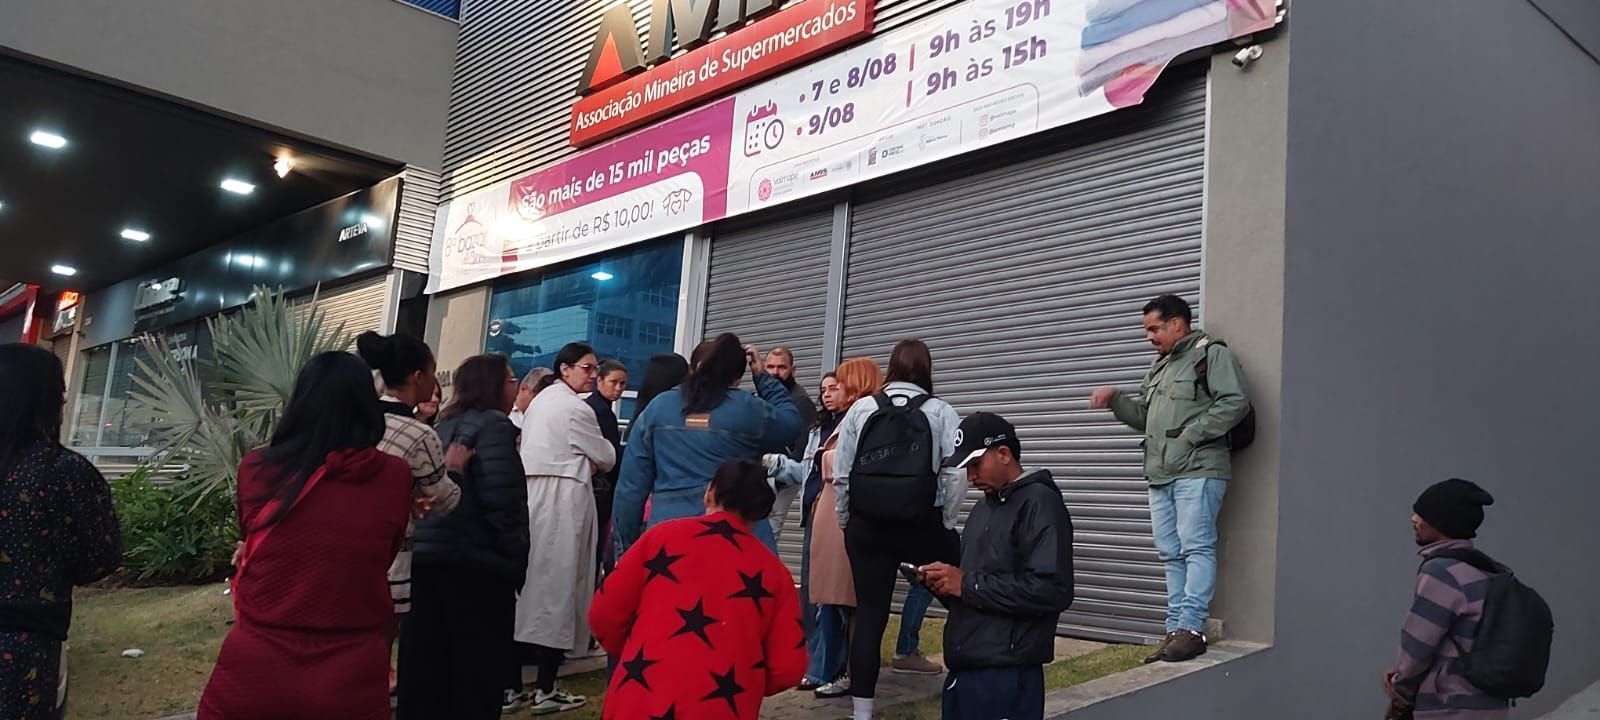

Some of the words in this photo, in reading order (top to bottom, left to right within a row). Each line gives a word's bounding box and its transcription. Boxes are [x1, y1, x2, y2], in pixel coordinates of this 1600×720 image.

[574, 91, 642, 132] Associação
[643, 68, 696, 105] Mineira
[699, 59, 718, 80] de
[722, 3, 856, 73] Supermercados
[808, 102, 855, 135] 9/08
[926, 68, 957, 96] 9h
[965, 58, 993, 82] às
[1002, 35, 1047, 70] 15h
[811, 80, 823, 102] 7
[829, 78, 841, 94] e
[846, 53, 897, 89] 8/08
[929, 30, 960, 58] 9h
[968, 20, 996, 44] às
[1004, 0, 1051, 30] 19h
[521, 190, 545, 209] São
[549, 177, 582, 204] mais
[585, 170, 605, 188] de
[608, 162, 624, 185] 15
[627, 150, 653, 180] mil
[656, 135, 711, 174] peças
[572, 220, 589, 240] de
[593, 214, 611, 234] R$
[614, 200, 654, 229] 10,00!
